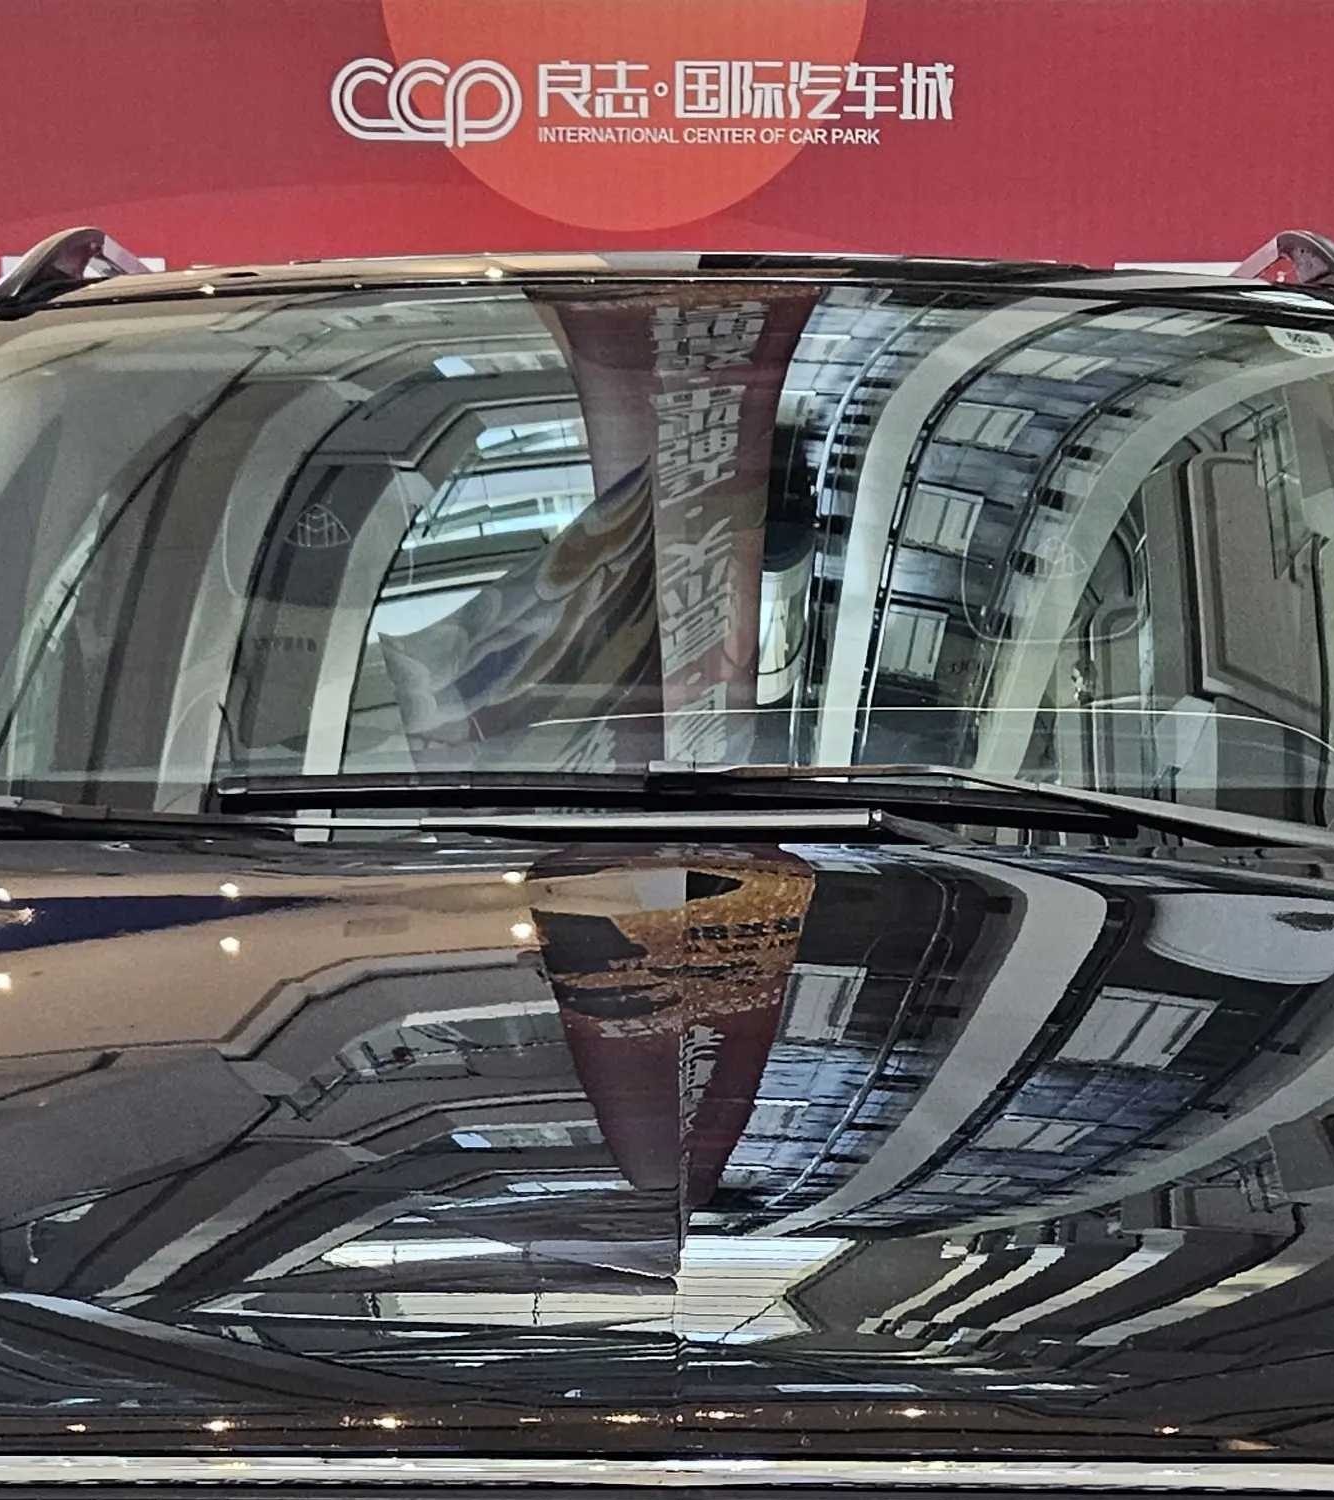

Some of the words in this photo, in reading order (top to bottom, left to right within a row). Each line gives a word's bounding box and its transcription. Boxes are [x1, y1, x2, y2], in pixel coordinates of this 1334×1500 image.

[538, 127, 679, 145] INTERNATIONAL
[683, 127, 756, 145] CENTER
[760, 127, 785, 145] OF
[789, 127, 828, 145] CAR
[831, 127, 881, 145] PARK
